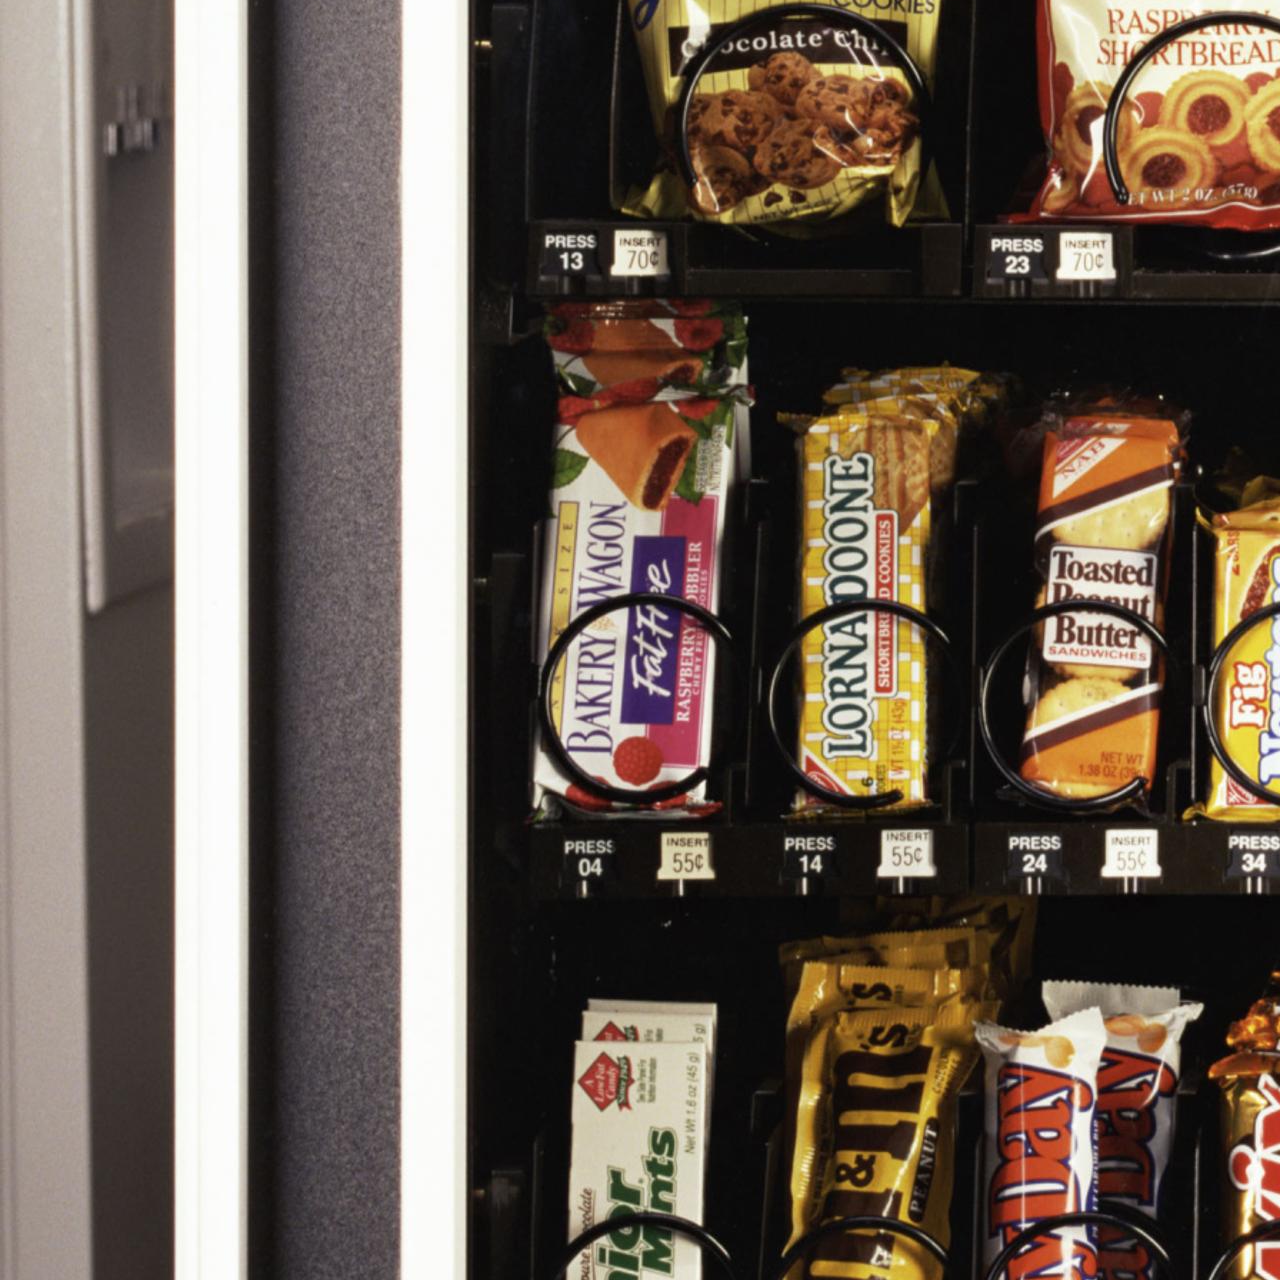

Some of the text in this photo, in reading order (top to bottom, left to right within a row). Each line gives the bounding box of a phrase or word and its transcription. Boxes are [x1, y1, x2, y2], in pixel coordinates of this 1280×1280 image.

[545, 235, 596, 248] PRESS
[619, 237, 660, 247] INSERT
[560, 253, 583, 269] 13
[626, 250, 659, 269] 70¢
[830, 456, 873, 600] DOONE
[878, 521, 893, 584] COOKIES
[1052, 551, 1153, 587] Toasted
[1053, 616, 1144, 649] Butter
[1048, 646, 1147, 662] SANDWICHES
[1232, 665, 1267, 730] Fig
[1008, 836, 1061, 851] PRESS
[1022, 855, 1047, 872] 24
[911, 1125, 936, 1215] PEANUT
[642, 1128, 676, 1275] Mints
